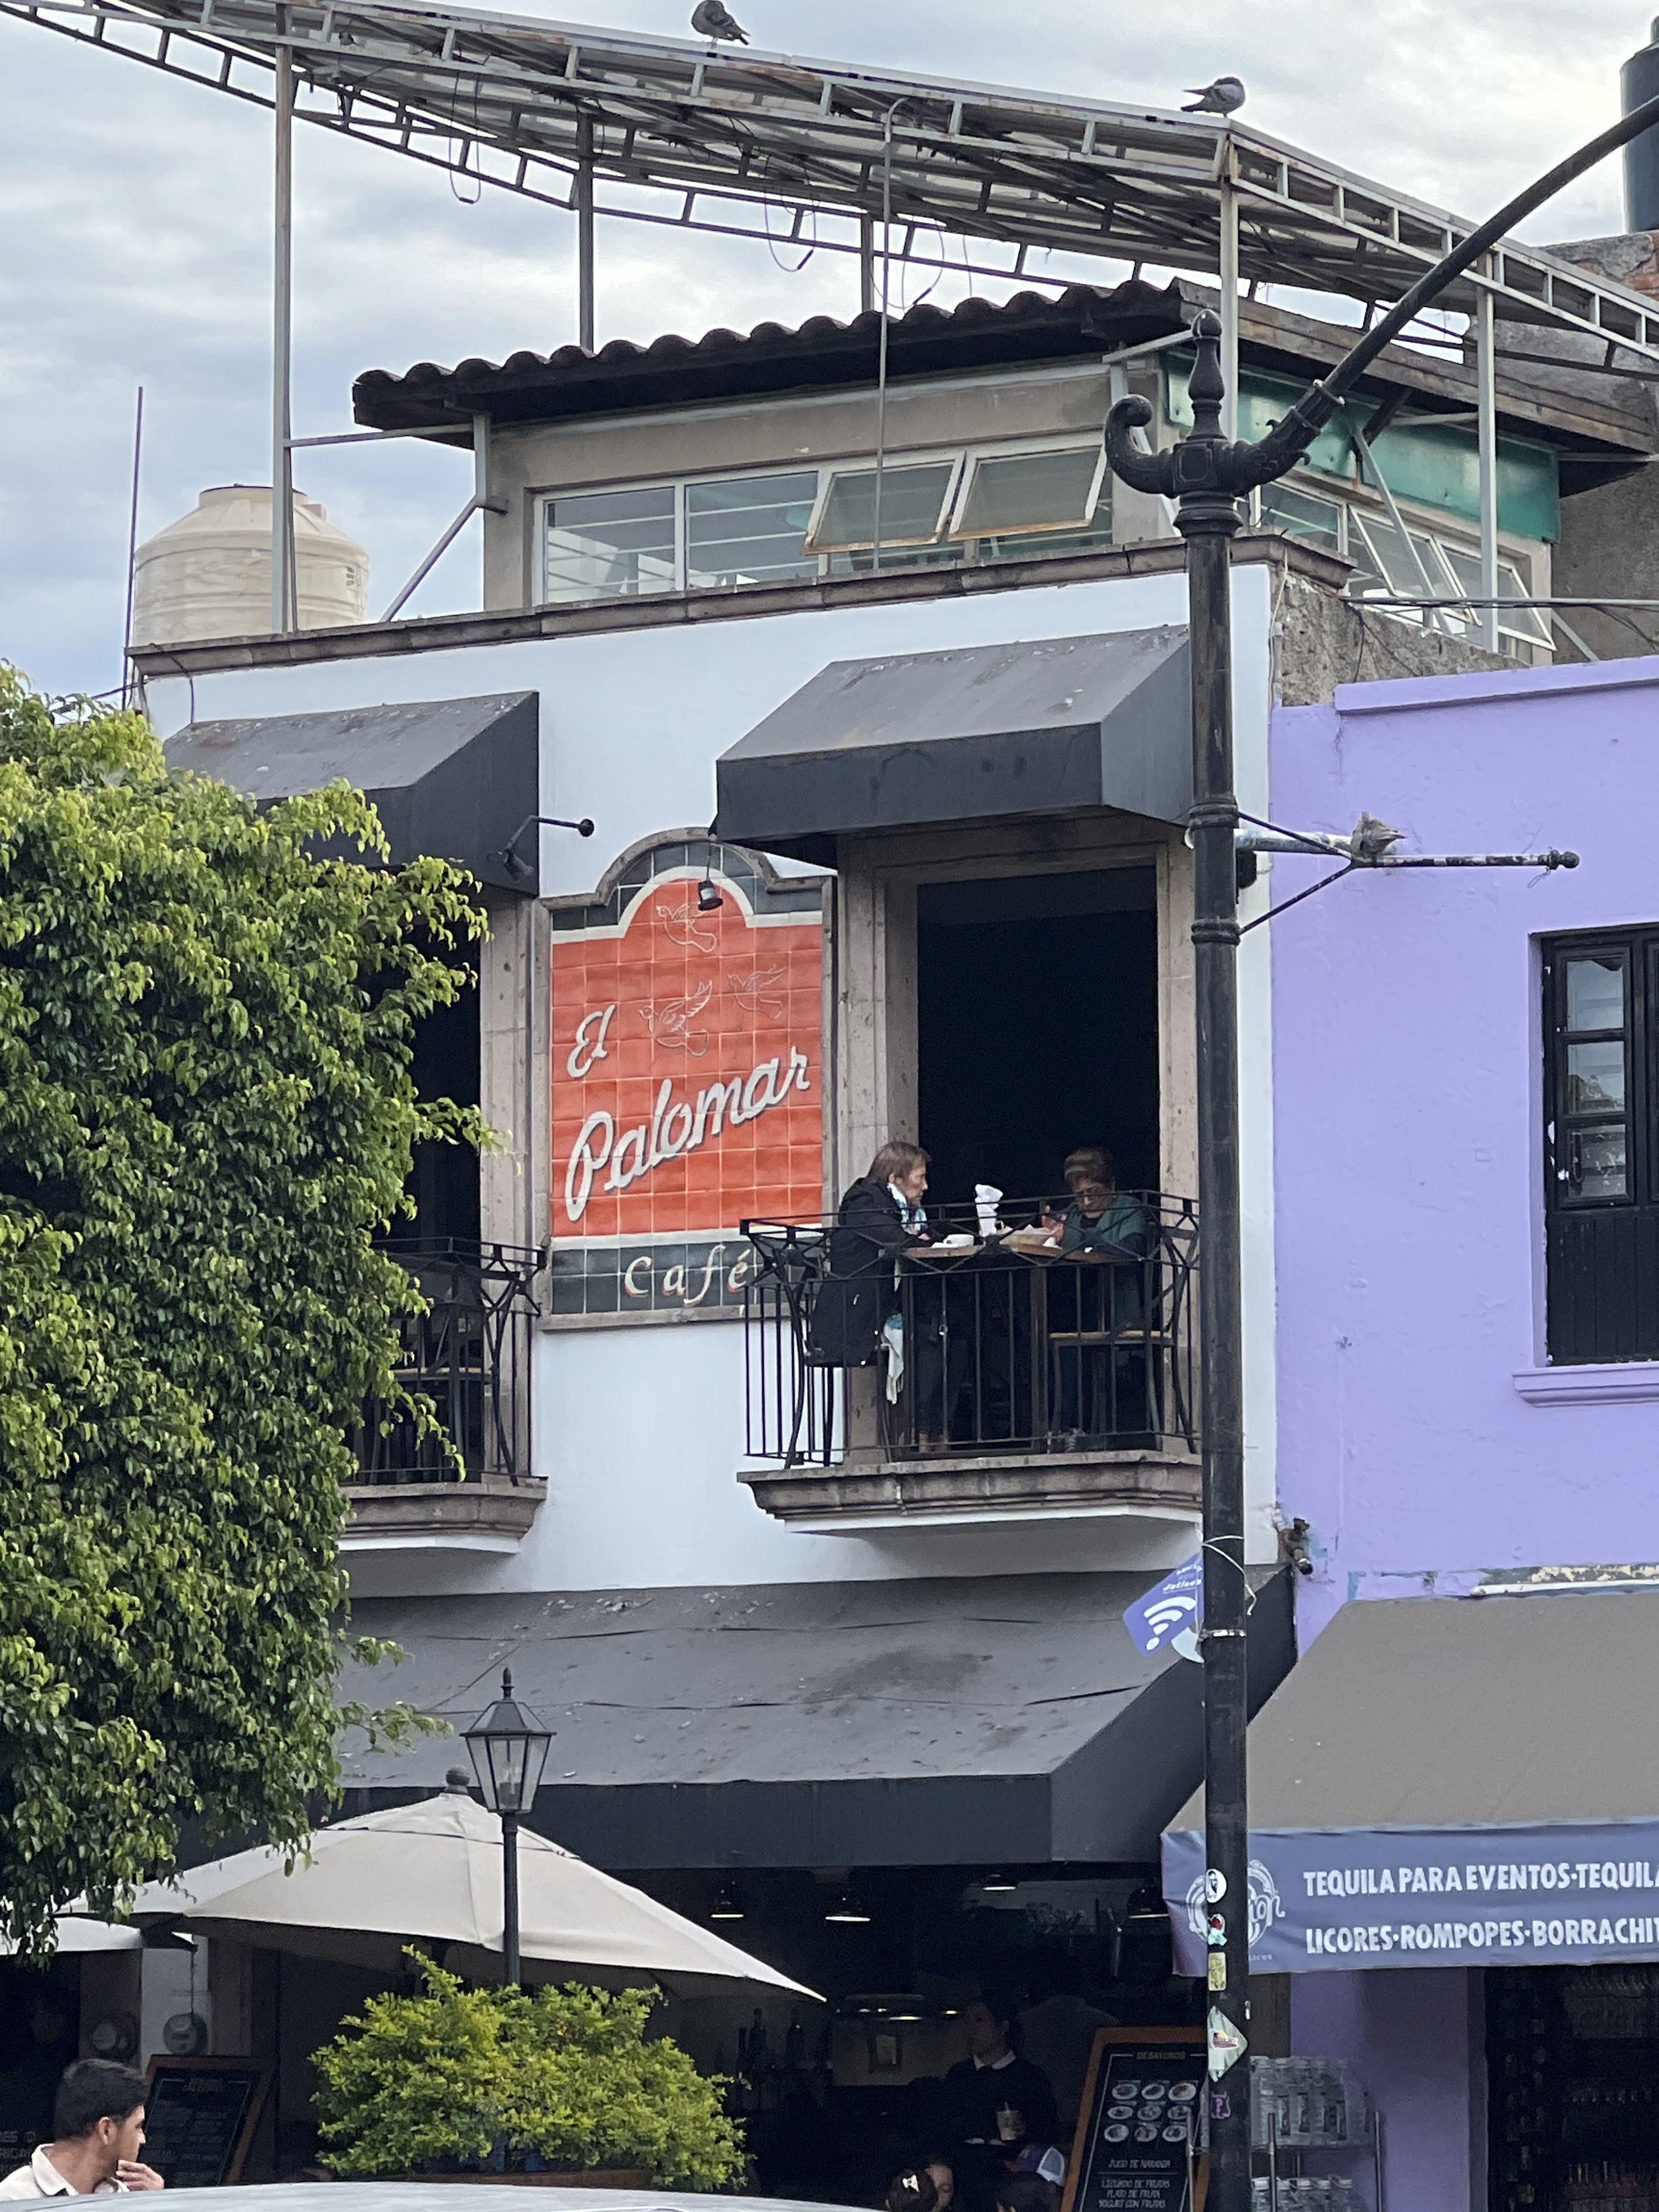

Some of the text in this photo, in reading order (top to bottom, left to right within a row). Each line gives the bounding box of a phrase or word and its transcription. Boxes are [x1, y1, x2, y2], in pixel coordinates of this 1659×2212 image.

[567, 1004, 615, 1078] El
[565, 1045, 810, 1221] Palomar
[624, 1244, 751, 1308] Café
[1303, 1869, 1396, 1897] TEQUILA
[1398, 1865, 1463, 1893] PARA
